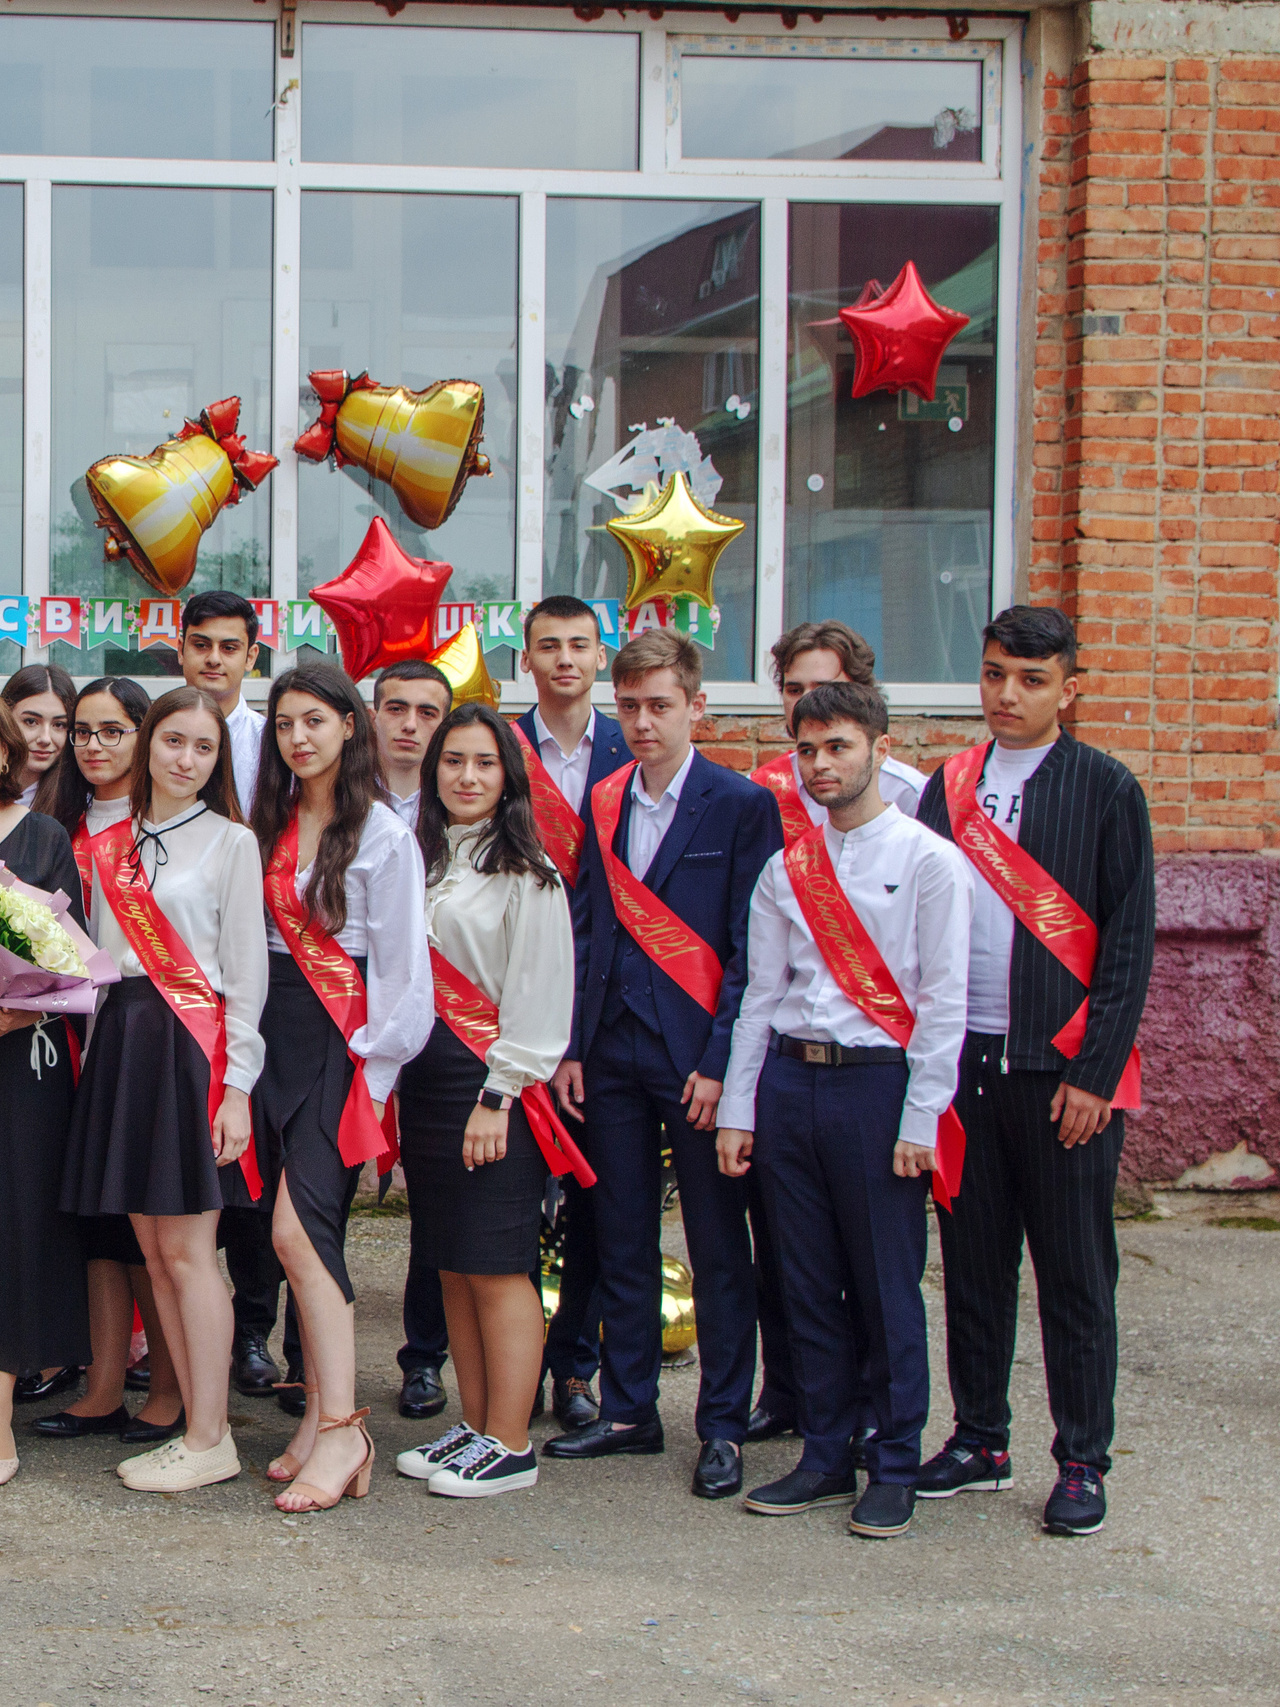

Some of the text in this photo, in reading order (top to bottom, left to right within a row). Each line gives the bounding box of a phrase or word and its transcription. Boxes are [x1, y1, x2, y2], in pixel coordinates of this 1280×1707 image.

[438, 601, 700, 640] ШКЛА!
[804, 873, 879, 993] Выпускник
[1012, 891, 1086, 939] 2021
[631, 916, 700, 960] 2021
[156, 966, 218, 1010] 2021
[301, 955, 362, 999] 2021
[442, 1000, 500, 1045] 2021
